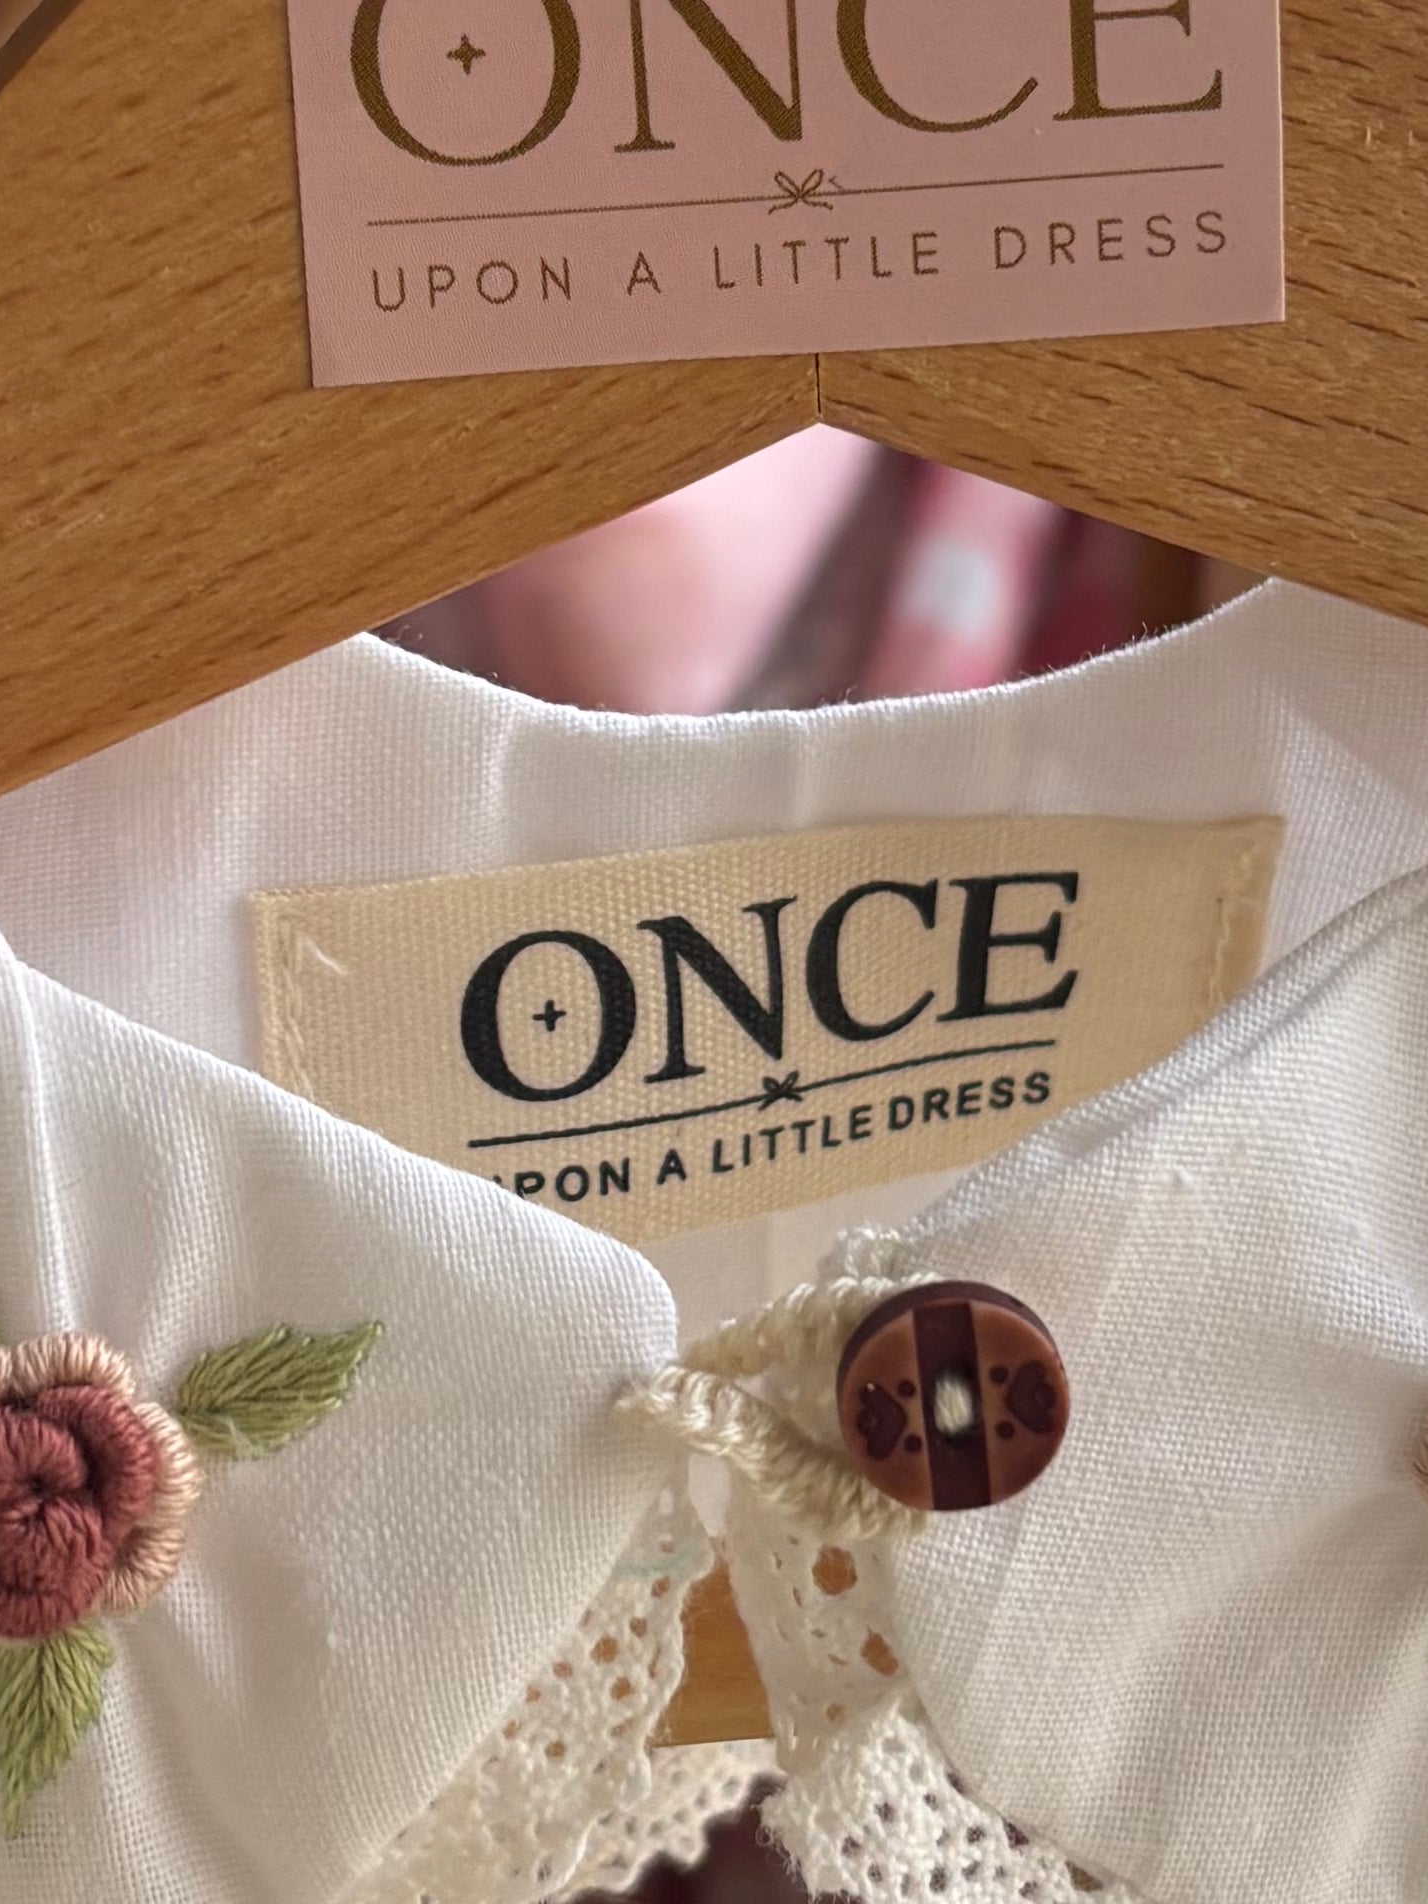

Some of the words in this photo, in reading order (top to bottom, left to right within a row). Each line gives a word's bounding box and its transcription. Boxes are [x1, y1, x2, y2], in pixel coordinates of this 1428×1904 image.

[370, 255, 573, 312] UPON
[625, 251, 662, 296] A
[712, 229, 939, 290] LITTLE
[993, 209, 1228, 272] DRESS
[459, 871, 1081, 1103] ONCE
[492, 1156, 631, 1202] PON
[656, 1149, 688, 1186] A
[711, 1105, 872, 1174] LITTLE
[887, 1071, 1051, 1131] DRESS
